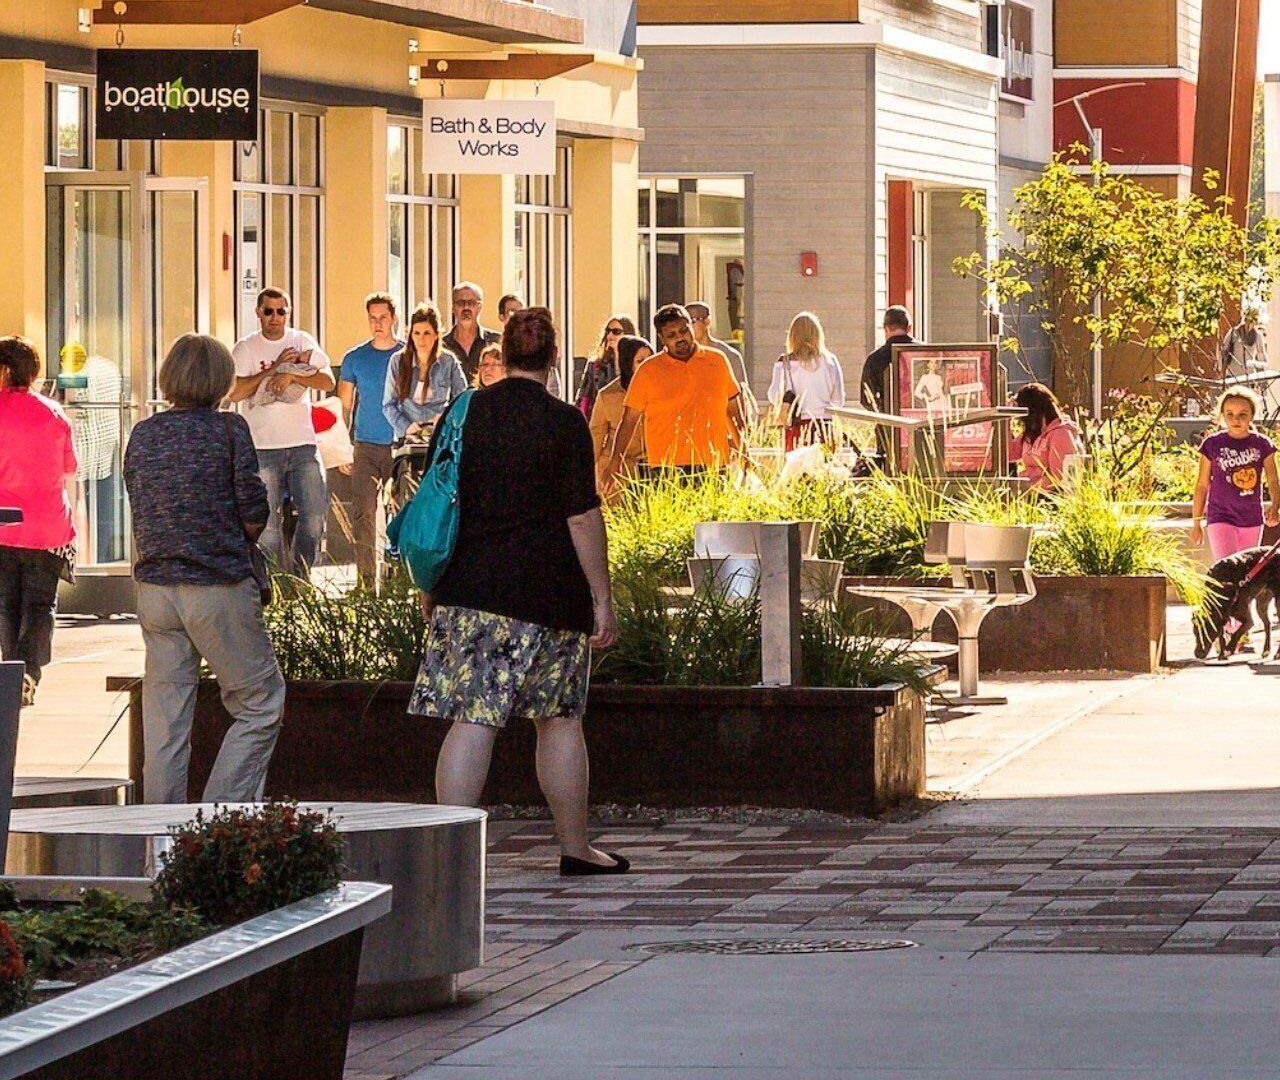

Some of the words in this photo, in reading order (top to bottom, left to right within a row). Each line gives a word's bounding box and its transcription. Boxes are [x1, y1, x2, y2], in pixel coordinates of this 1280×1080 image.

[105, 80, 250, 107] boathouse
[431, 117, 474, 133] Bath
[478, 118, 492, 133] &
[496, 118, 546, 137] Body
[459, 140, 519, 156] Works
